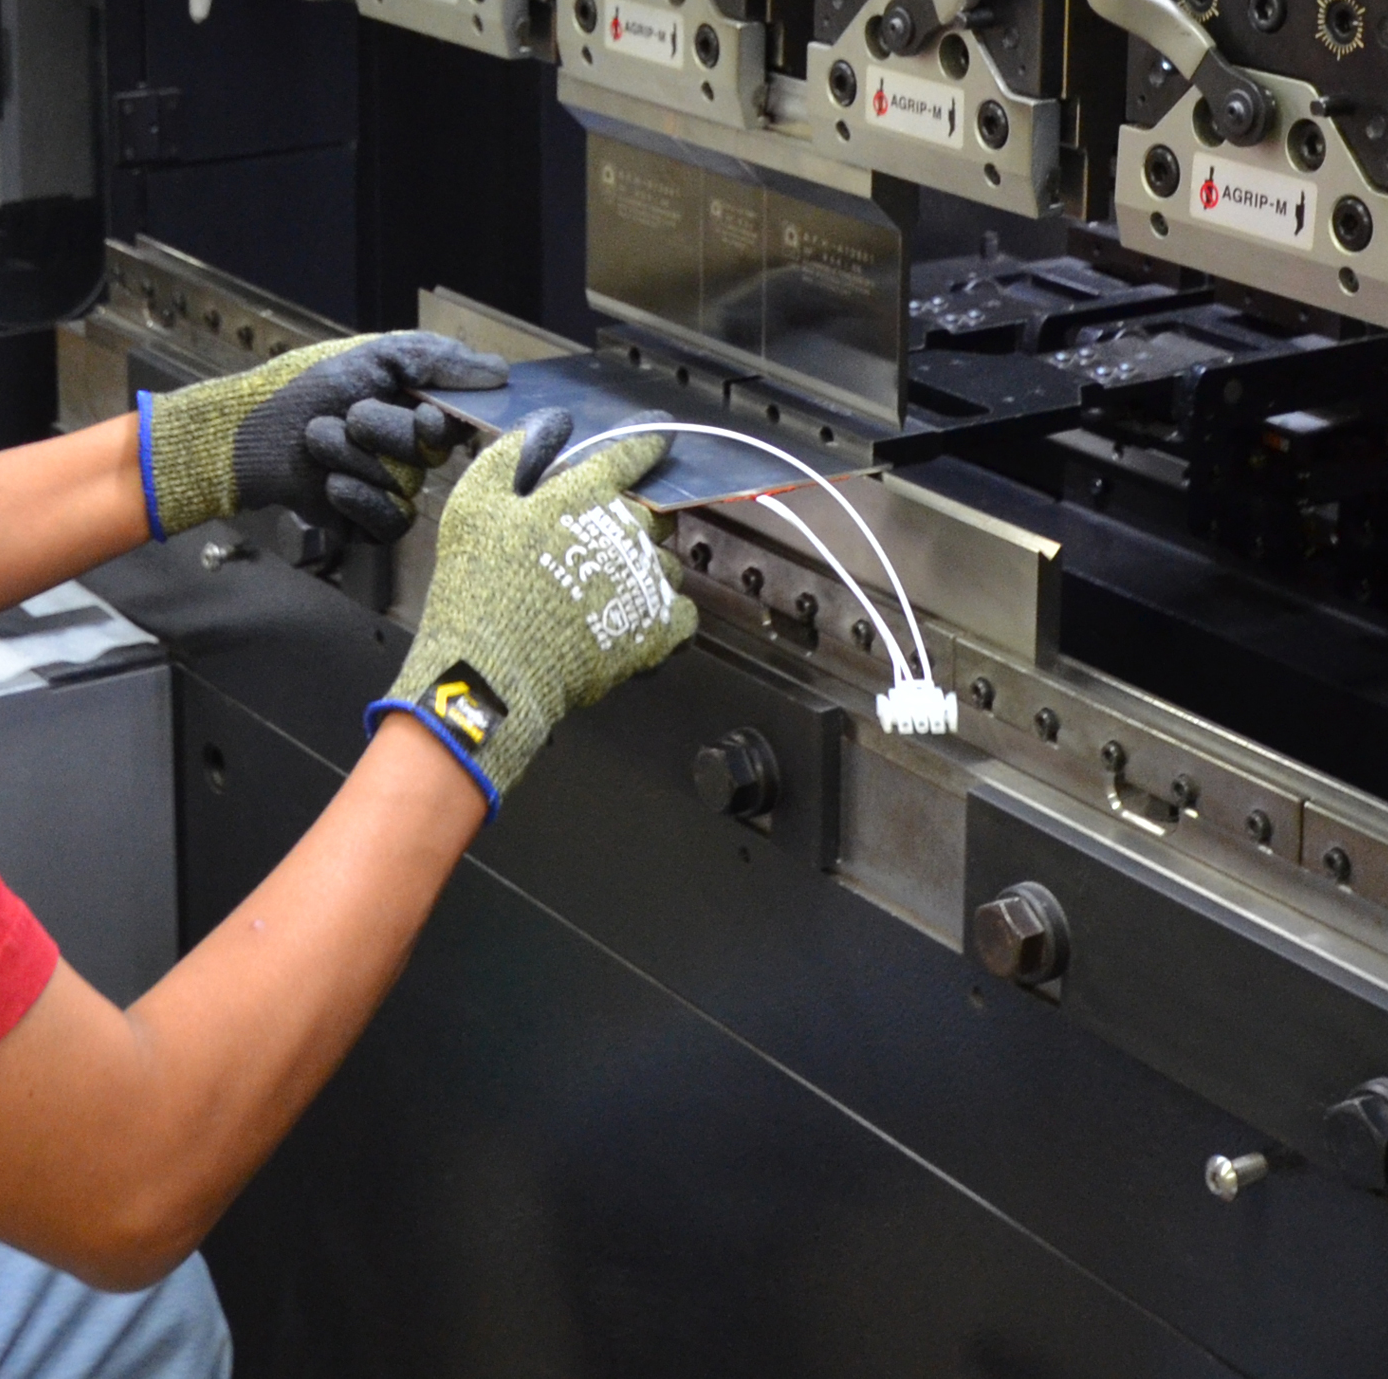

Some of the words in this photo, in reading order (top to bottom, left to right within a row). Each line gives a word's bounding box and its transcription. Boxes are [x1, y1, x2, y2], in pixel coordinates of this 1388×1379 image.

[625, 20, 666, 43] AGRIP-M
[890, 93, 942, 121] AGRIP-M
[1222, 184, 1288, 216] AGRIP-M
[539, 552, 573, 588] SIZE
[565, 544, 602, 582] CE
